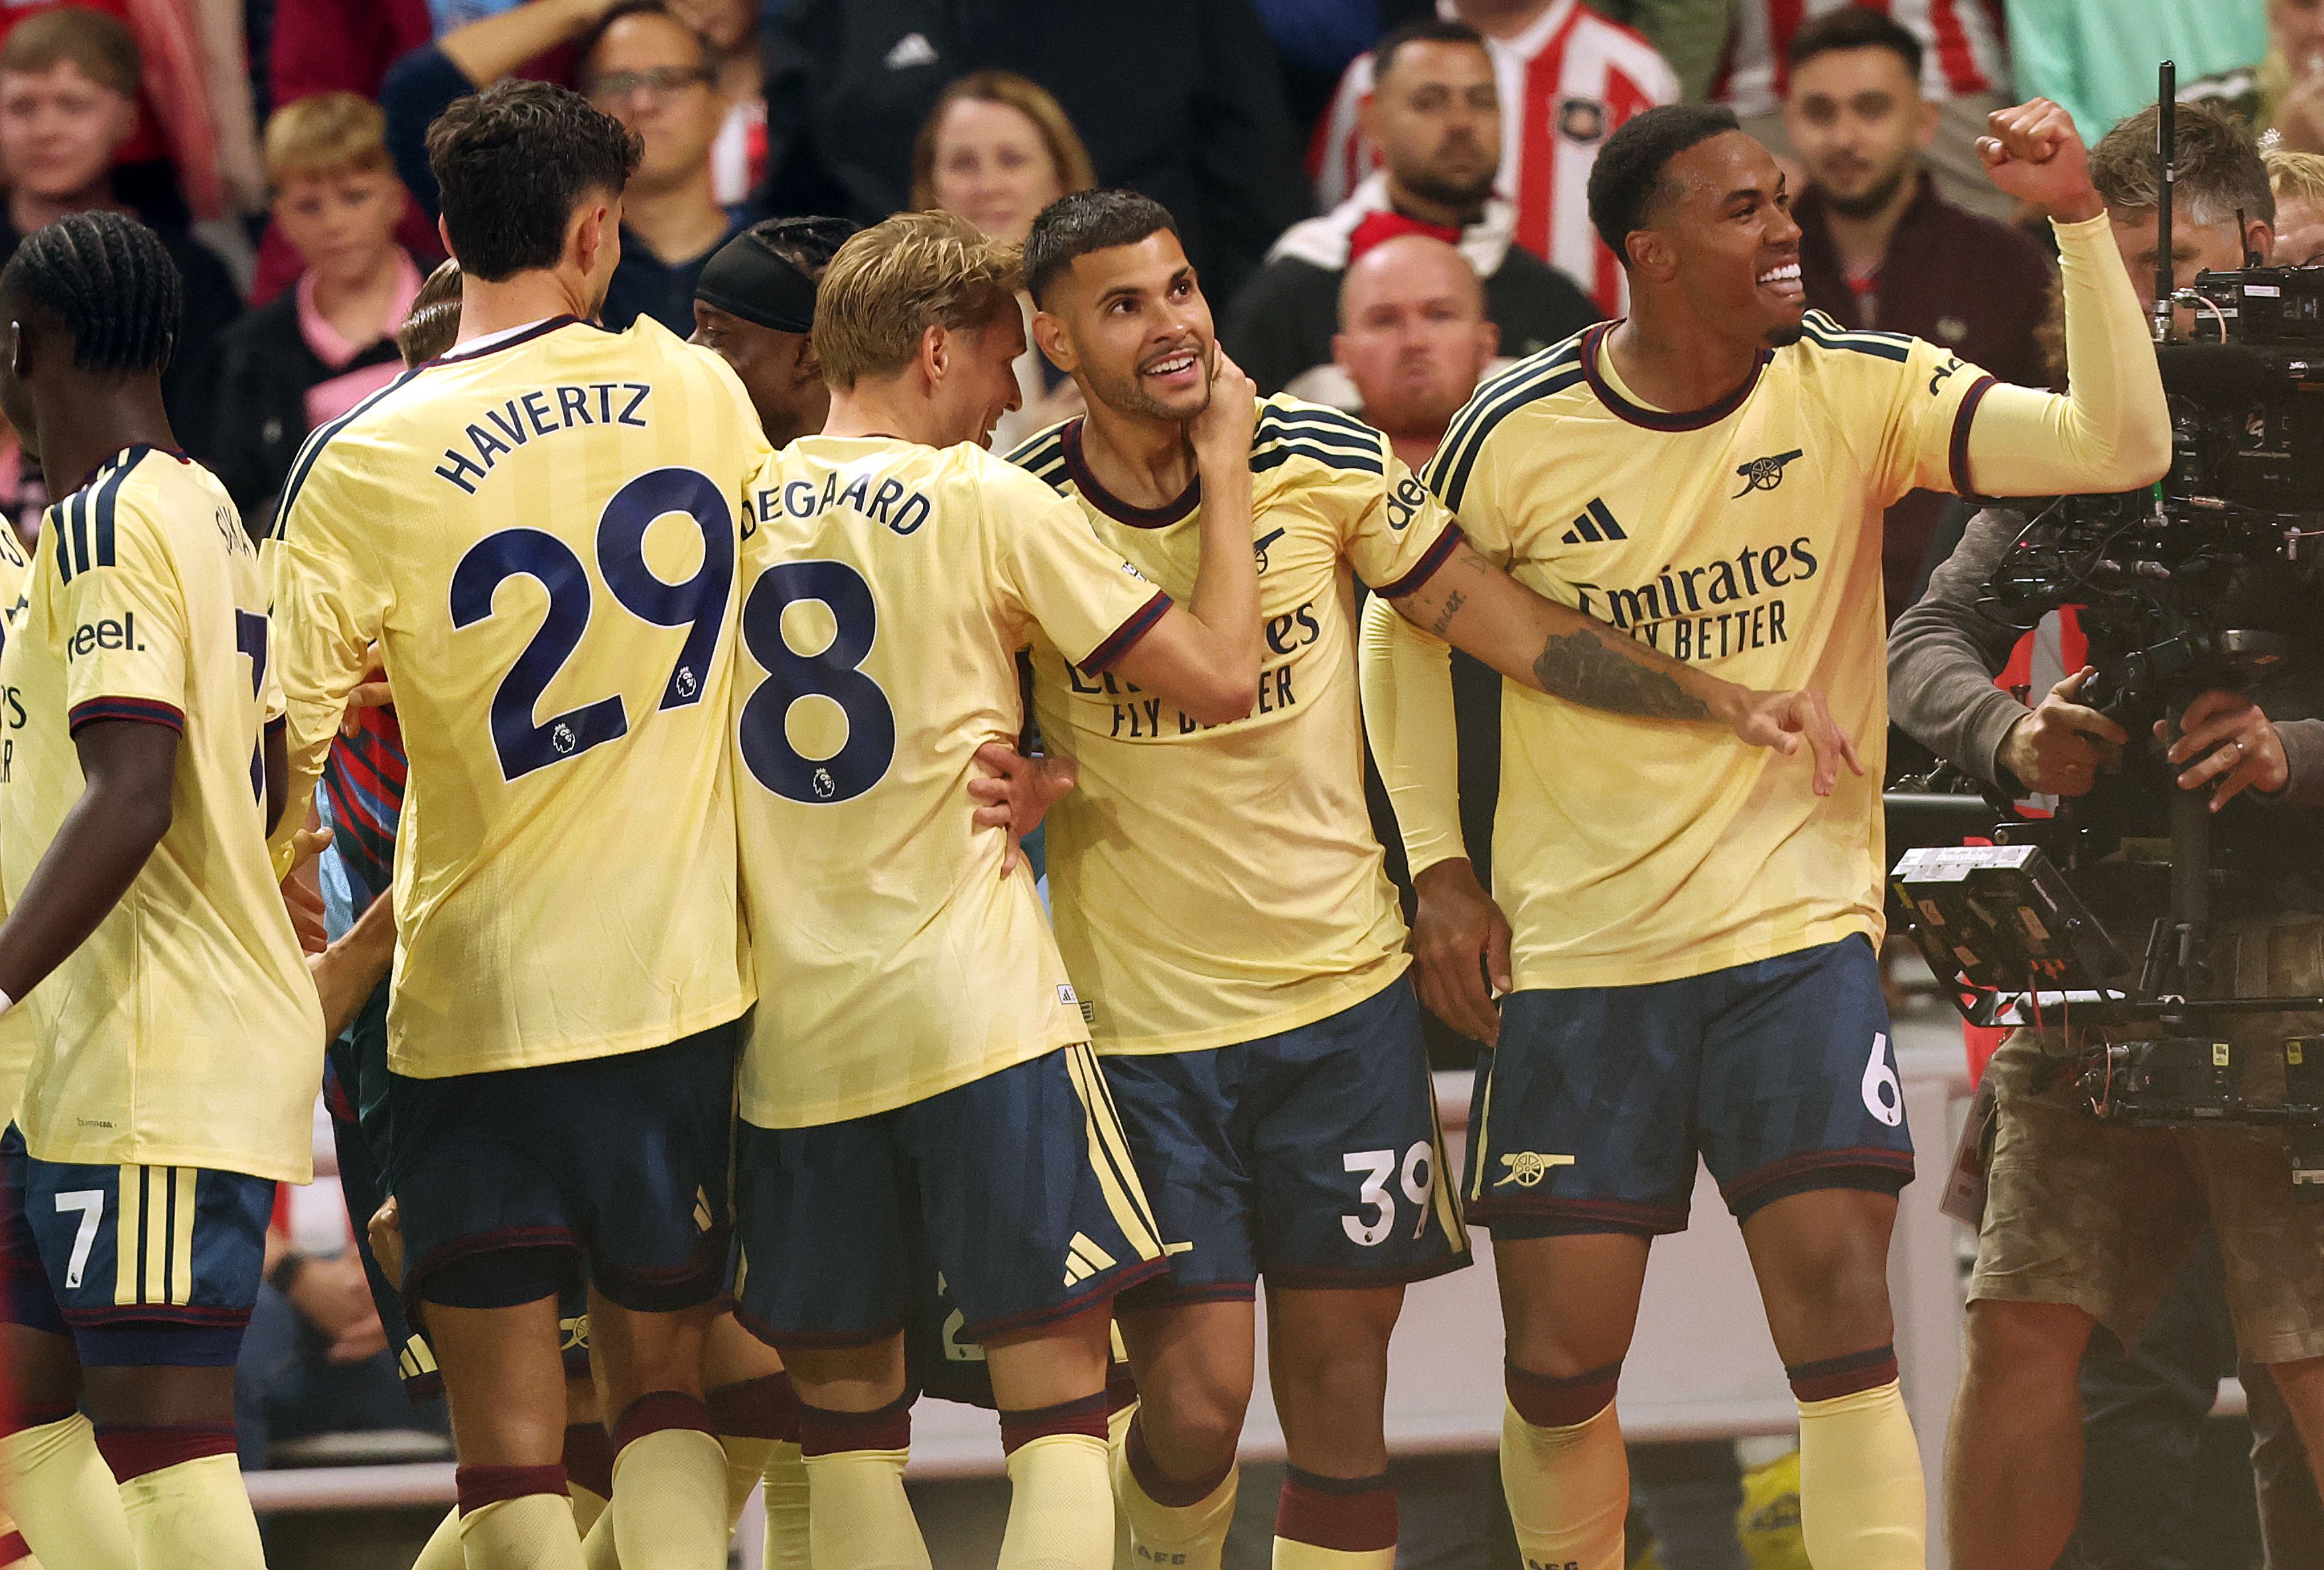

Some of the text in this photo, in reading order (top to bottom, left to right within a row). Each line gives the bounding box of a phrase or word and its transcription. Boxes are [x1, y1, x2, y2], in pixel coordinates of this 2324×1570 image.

[434, 382, 653, 495] HAVERTZ
[448, 464, 735, 783] 29
[1674, 599, 1788, 662] BETTER
[738, 559, 897, 805] 8
[1110, 697, 1161, 738] FLY
[1861, 1031, 1903, 1127] 6
[54, 1188, 105, 1289] 7
[1341, 1140, 1435, 1246] 39
